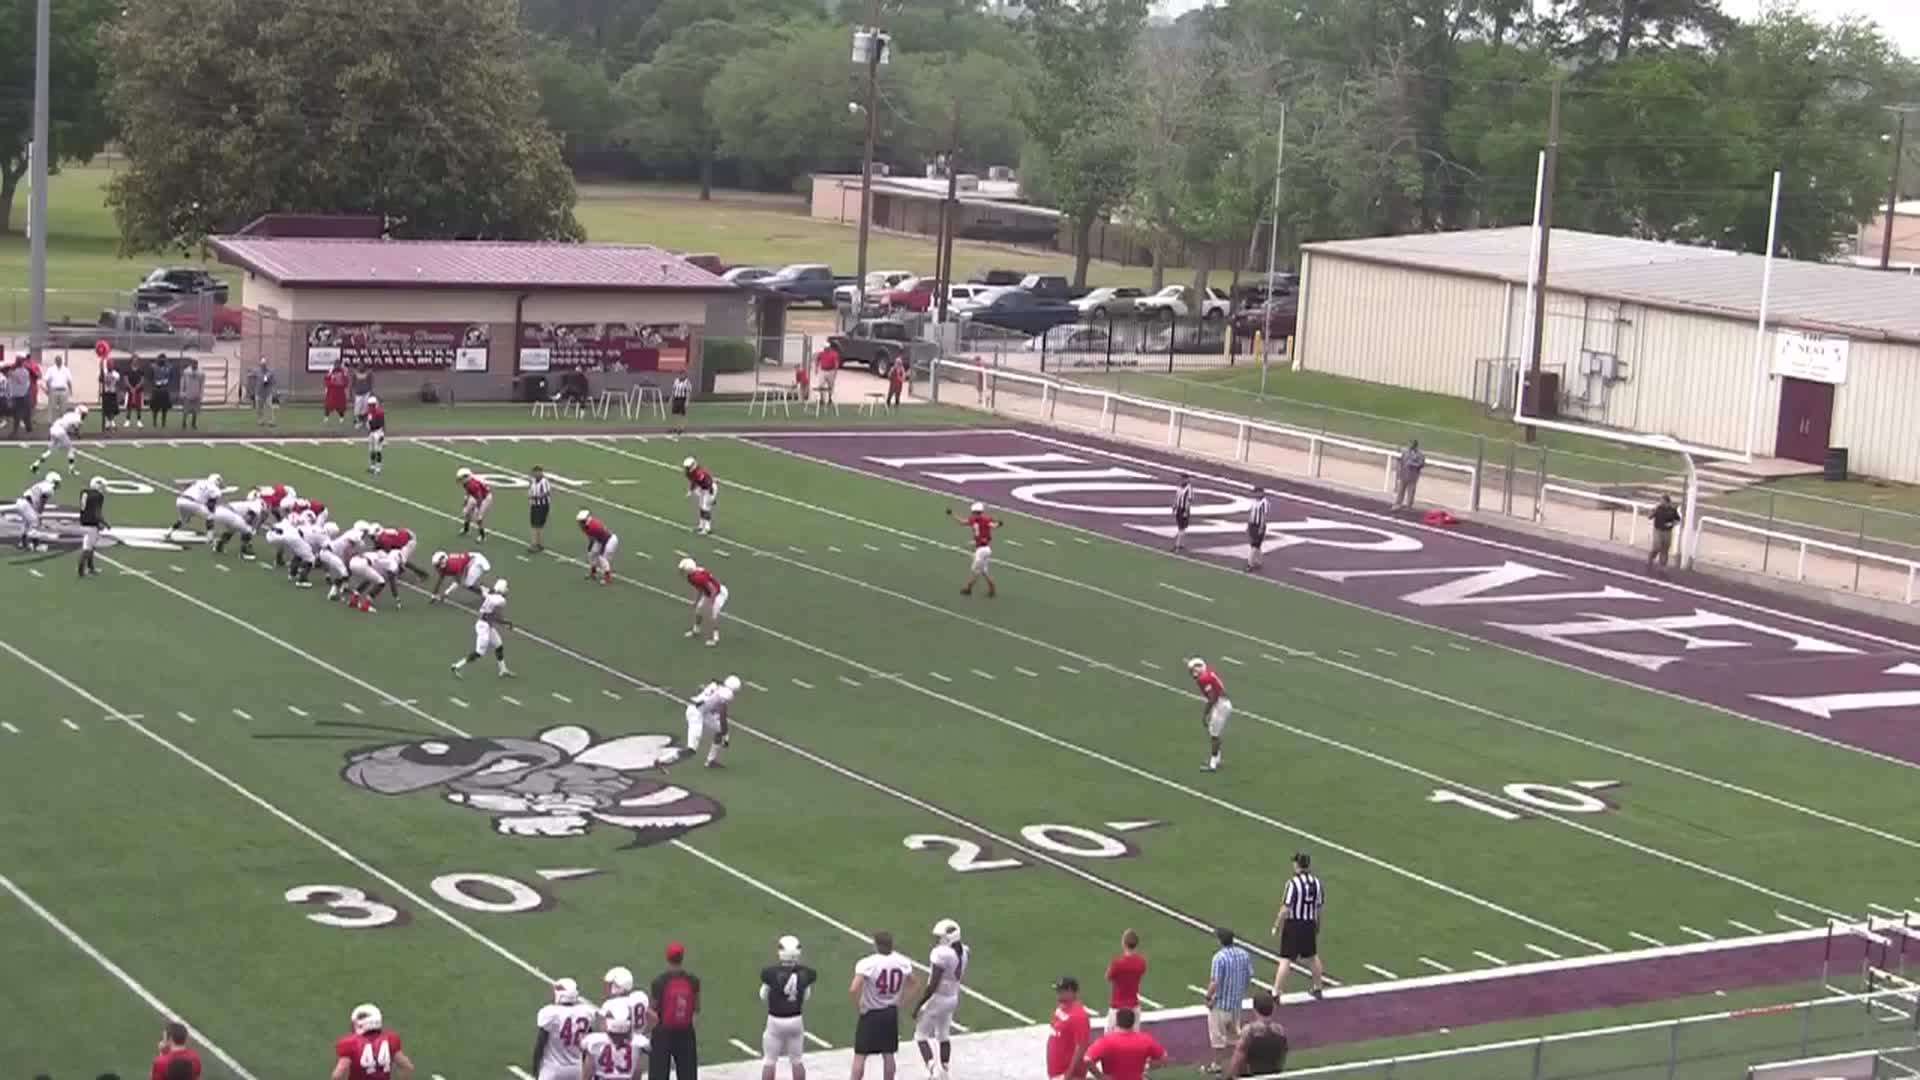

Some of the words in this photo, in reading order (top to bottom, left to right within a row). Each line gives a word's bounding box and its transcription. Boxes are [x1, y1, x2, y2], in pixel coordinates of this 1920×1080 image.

[1802, 331, 1823, 342] THE
[1428, 780, 1608, 820] 10
[903, 822, 1129, 874] 20
[284, 872, 544, 929] 30
[783, 972, 799, 1002] 4
[874, 967, 904, 995] 40
[559, 1015, 591, 1048] 42
[360, 1039, 391, 1075] 44
[598, 1042, 633, 1075] 43
